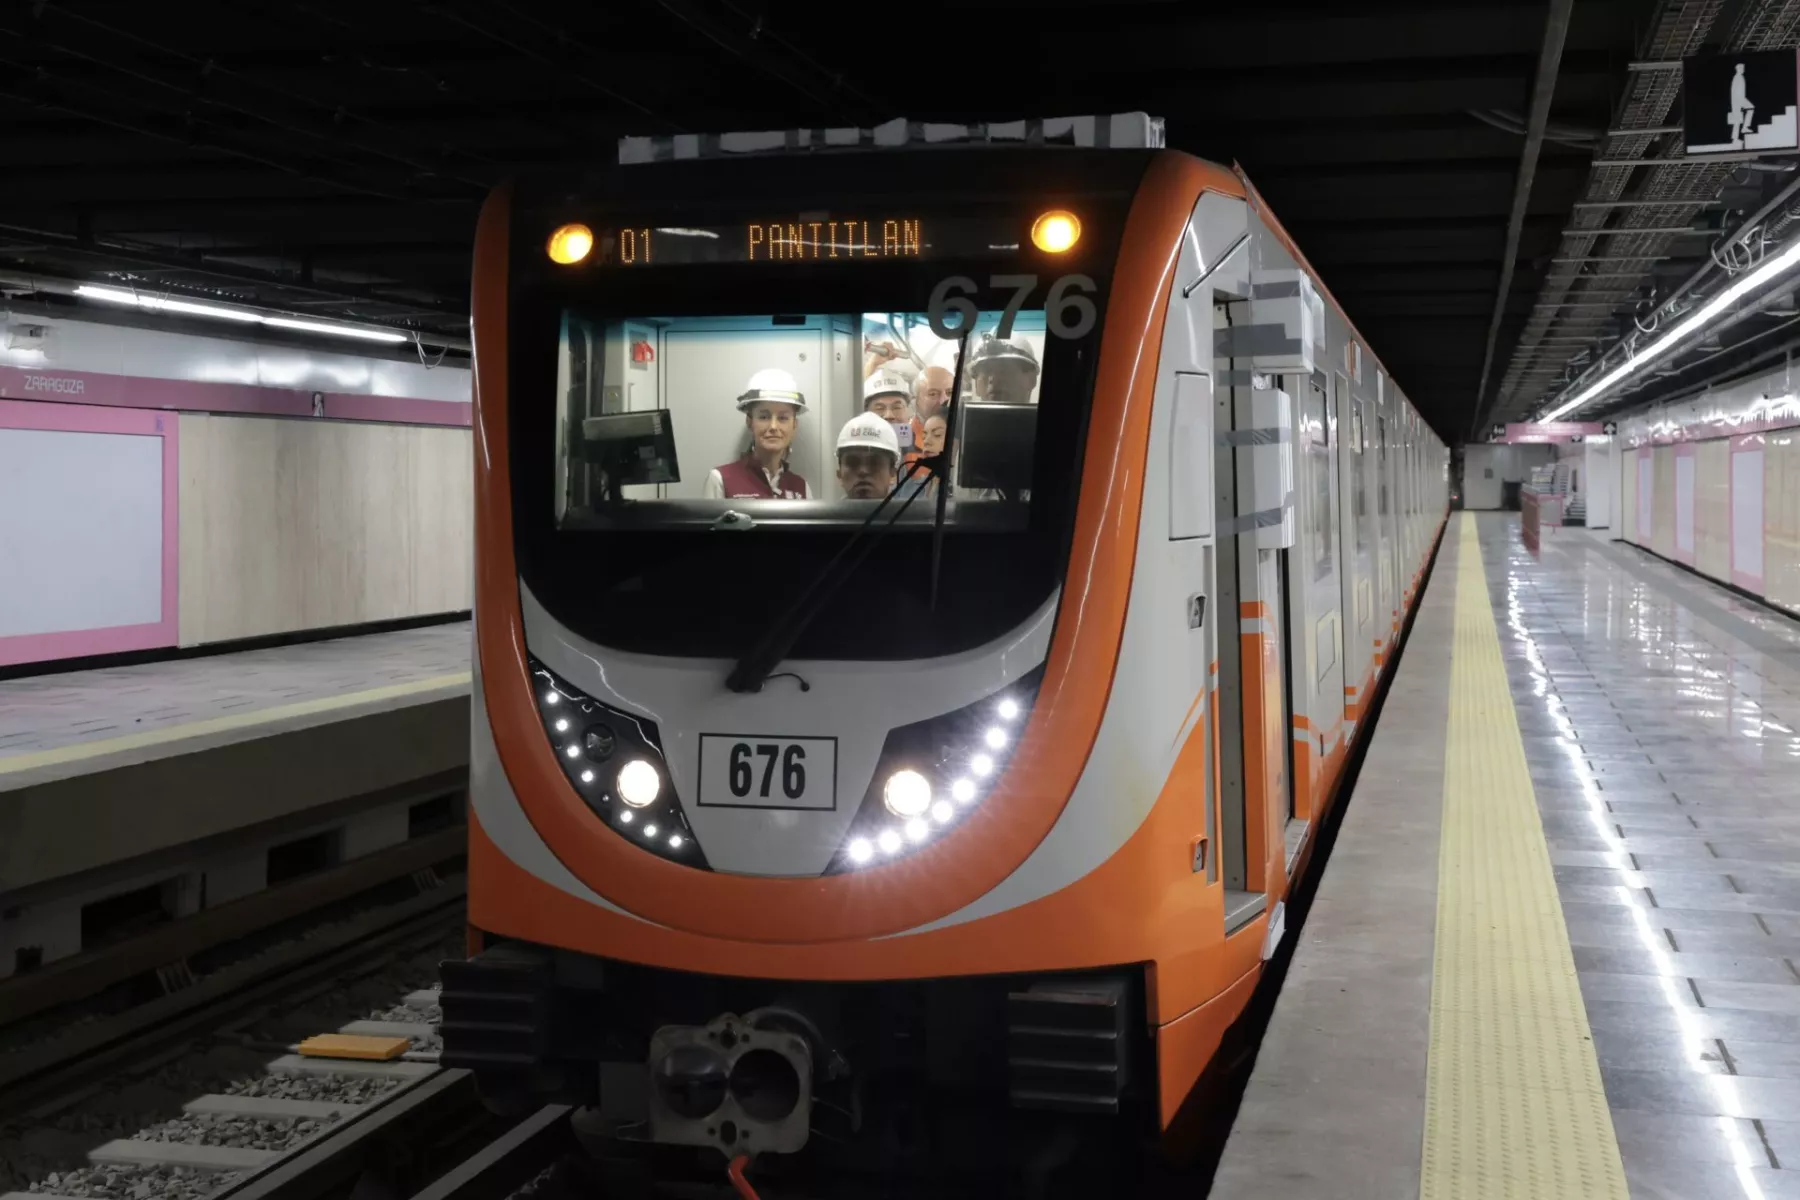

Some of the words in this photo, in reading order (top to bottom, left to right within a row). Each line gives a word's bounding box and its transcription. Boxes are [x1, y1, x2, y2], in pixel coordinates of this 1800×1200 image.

[621, 228, 649, 263] 01
[749, 220, 918, 260] PANTITLAN
[928, 273, 1097, 340] 676
[24, 375, 84, 394] ZARAGOZA
[729, 742, 806, 799] 676
